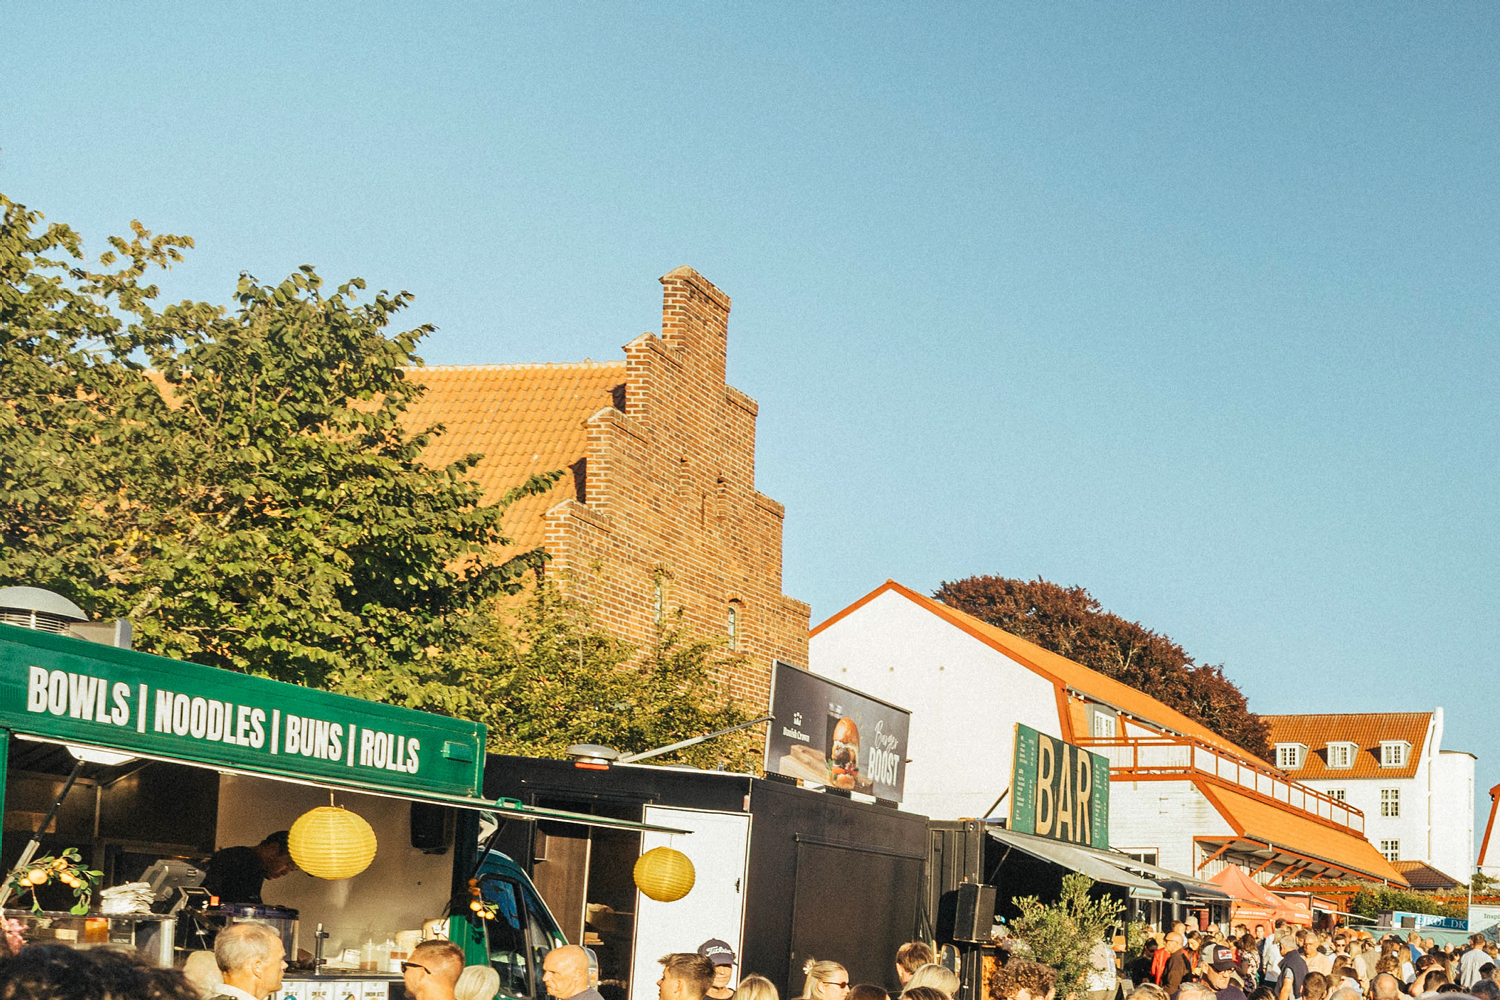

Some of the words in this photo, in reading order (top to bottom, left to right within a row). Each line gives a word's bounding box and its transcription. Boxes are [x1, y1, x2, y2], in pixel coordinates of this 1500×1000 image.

[27, 665, 130, 727] BOWLS
[154, 689, 265, 749] NOODLES
[285, 714, 342, 761] BUNS
[359, 728, 420, 774] ROLLS
[867, 746, 900, 787] BOOST
[1036, 734, 1092, 845] BAR
